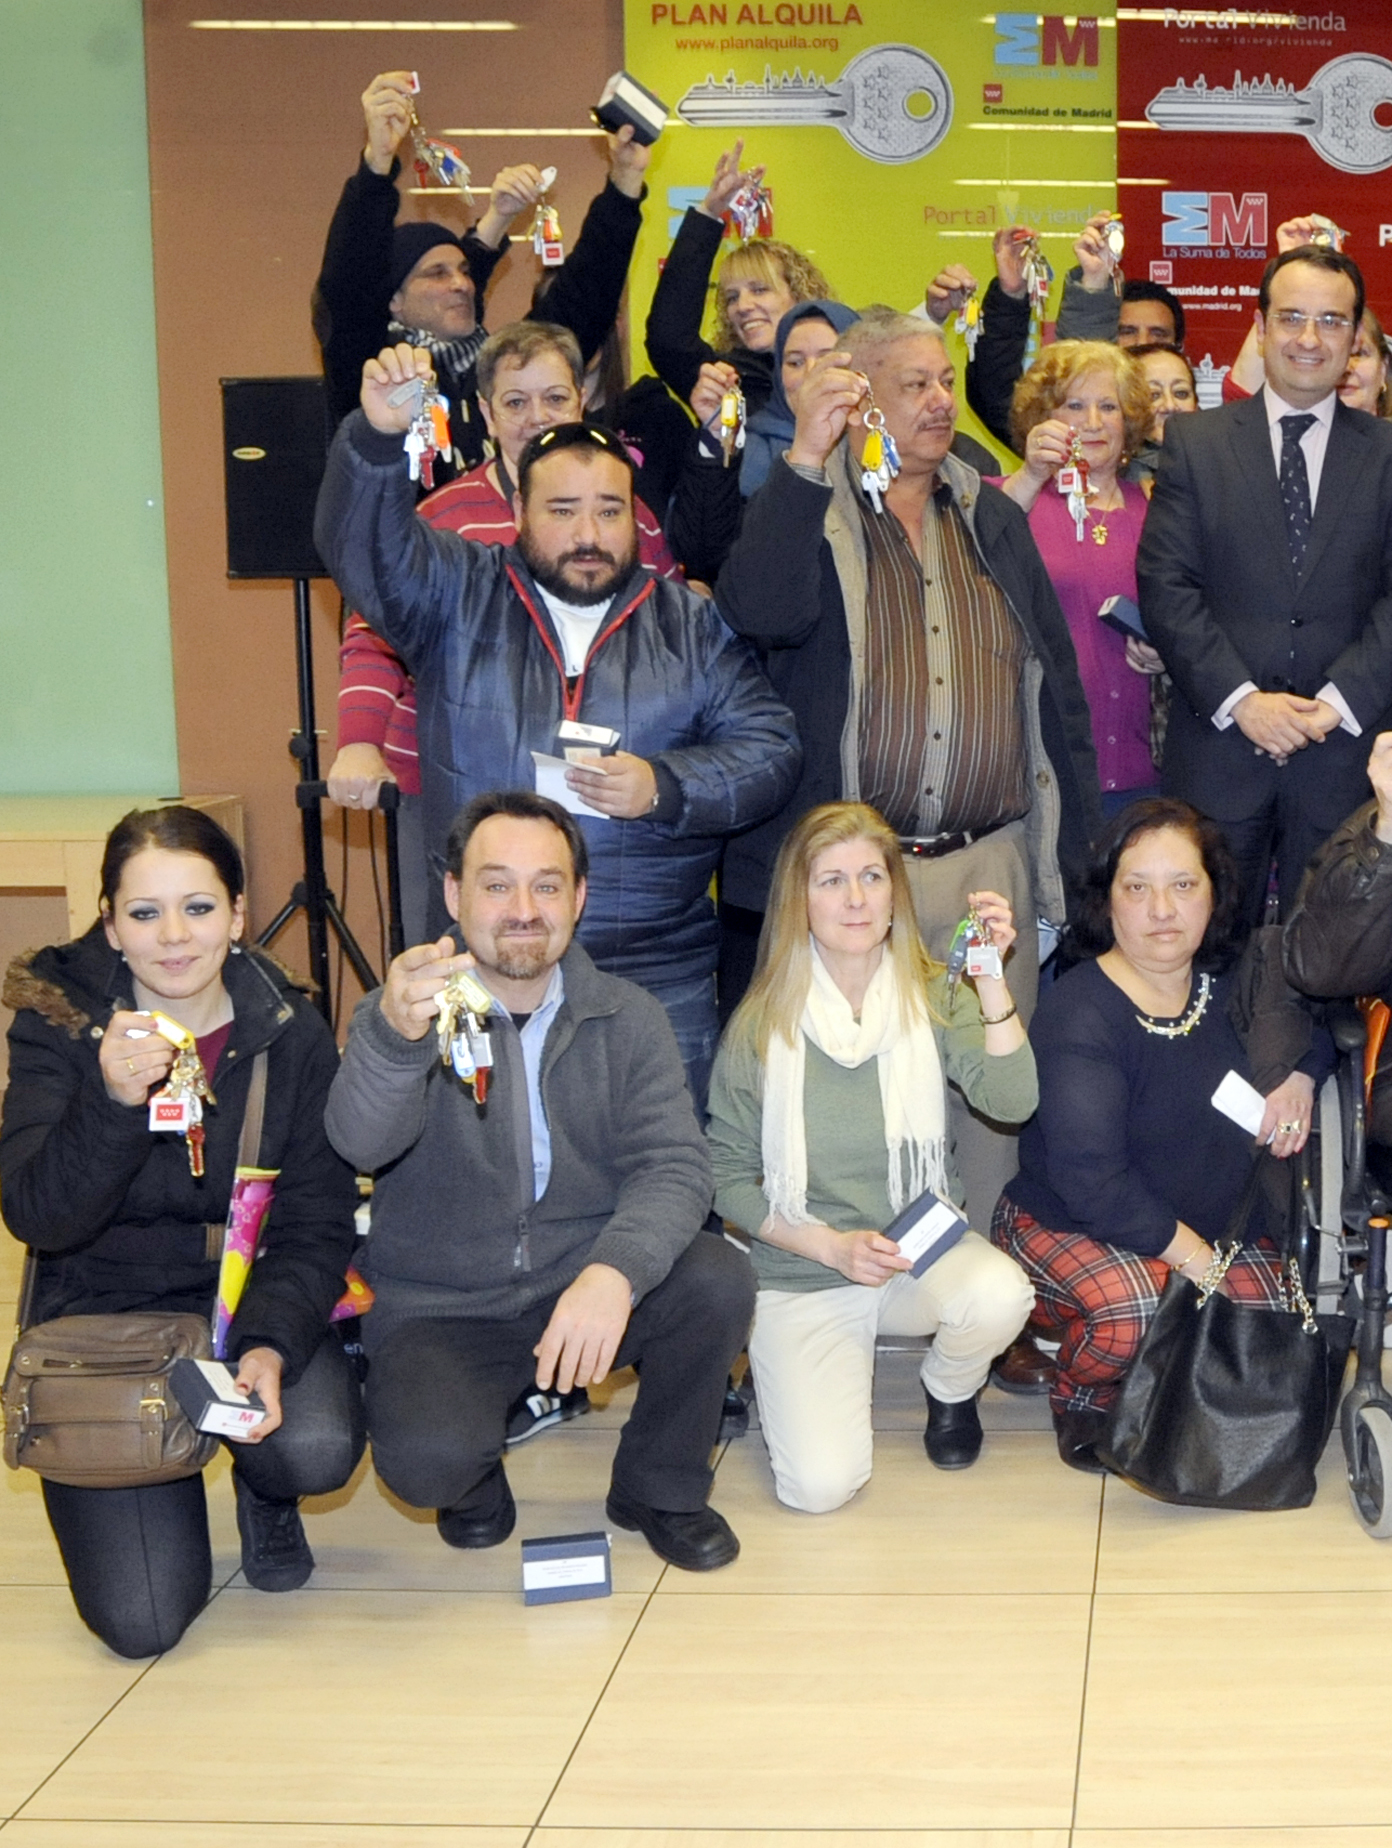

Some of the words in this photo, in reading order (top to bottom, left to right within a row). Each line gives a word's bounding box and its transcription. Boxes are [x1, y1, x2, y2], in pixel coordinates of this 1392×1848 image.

[651, 3, 728, 26] PLAN
[736, 3, 864, 26] ALQUILA
[675, 35, 839, 53] www.planalquila.org
[982, 106, 1049, 117] Comunidad
[1053, 108, 1067, 117] de
[1071, 108, 1112, 118] Madrid
[923, 205, 997, 225] Portal
[1162, 246, 1177, 258] La
[1179, 247, 1212, 258] Suma
[1215, 247, 1230, 258] de
[1232, 247, 1267, 259] Todos
[1166, 285, 1218, 296] munidad
[1220, 285, 1236, 296] de
